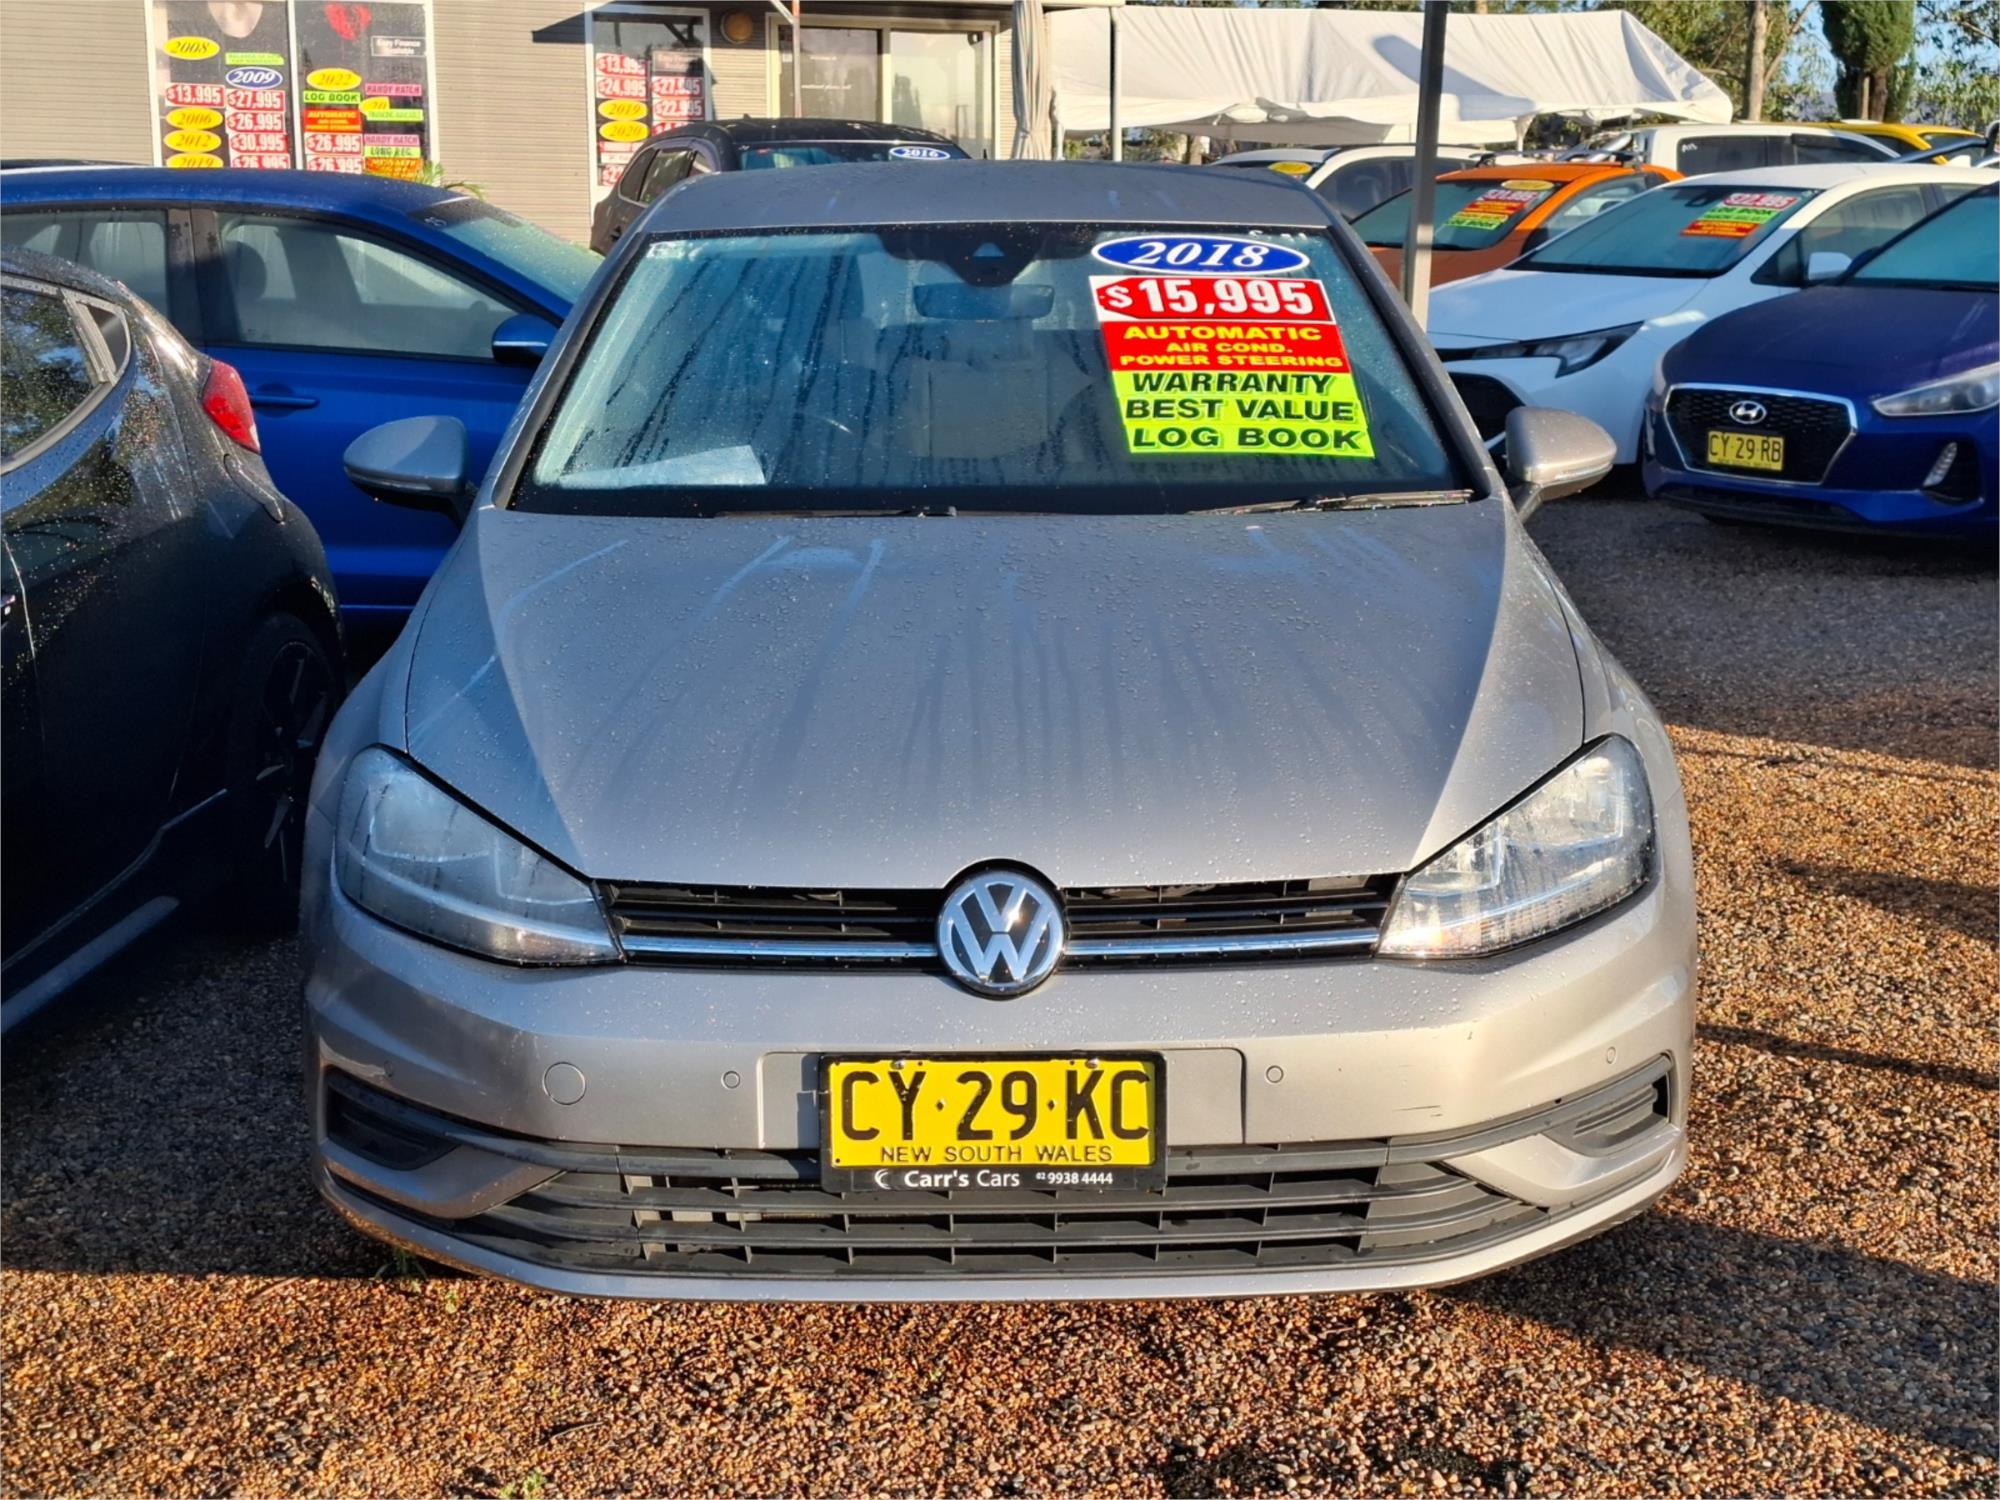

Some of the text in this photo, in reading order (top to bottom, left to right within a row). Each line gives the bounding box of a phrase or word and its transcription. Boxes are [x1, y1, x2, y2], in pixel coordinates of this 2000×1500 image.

[170, 41, 210, 54] 2008
[231, 71, 276, 84] 2009
[166, 85, 221, 104] $13,995
[228, 90, 281, 110] $27,995
[304, 93, 359, 102] LOG BOOK
[177, 112, 213, 126] 2006
[228, 113, 282, 132] $26,995
[175, 134, 212, 148] 2012
[231, 134, 285, 152] $30,995
[307, 135, 360, 152] $26,995
[903, 148, 939, 158] 2016
[1128, 241, 1271, 267] 2018
[1123, 326, 1323, 341] AUTOMATIC
[1166, 342, 1293, 354] AIR COND.
[1120, 355, 1344, 368] POWER STEERING
[1132, 372, 1334, 394] WARRANTY
[1125, 399, 1356, 421] BEST VALUE
[1132, 427, 1365, 450] LOG BOOK
[880, 1145, 1113, 1163] NEW SOUTH WALES
[903, 1169, 970, 1188] Carr's
[976, 1169, 1021, 1188] Cars
[1047, 1172, 1080, 1185] 9938
[1081, 1172, 1114, 1185] 4444
